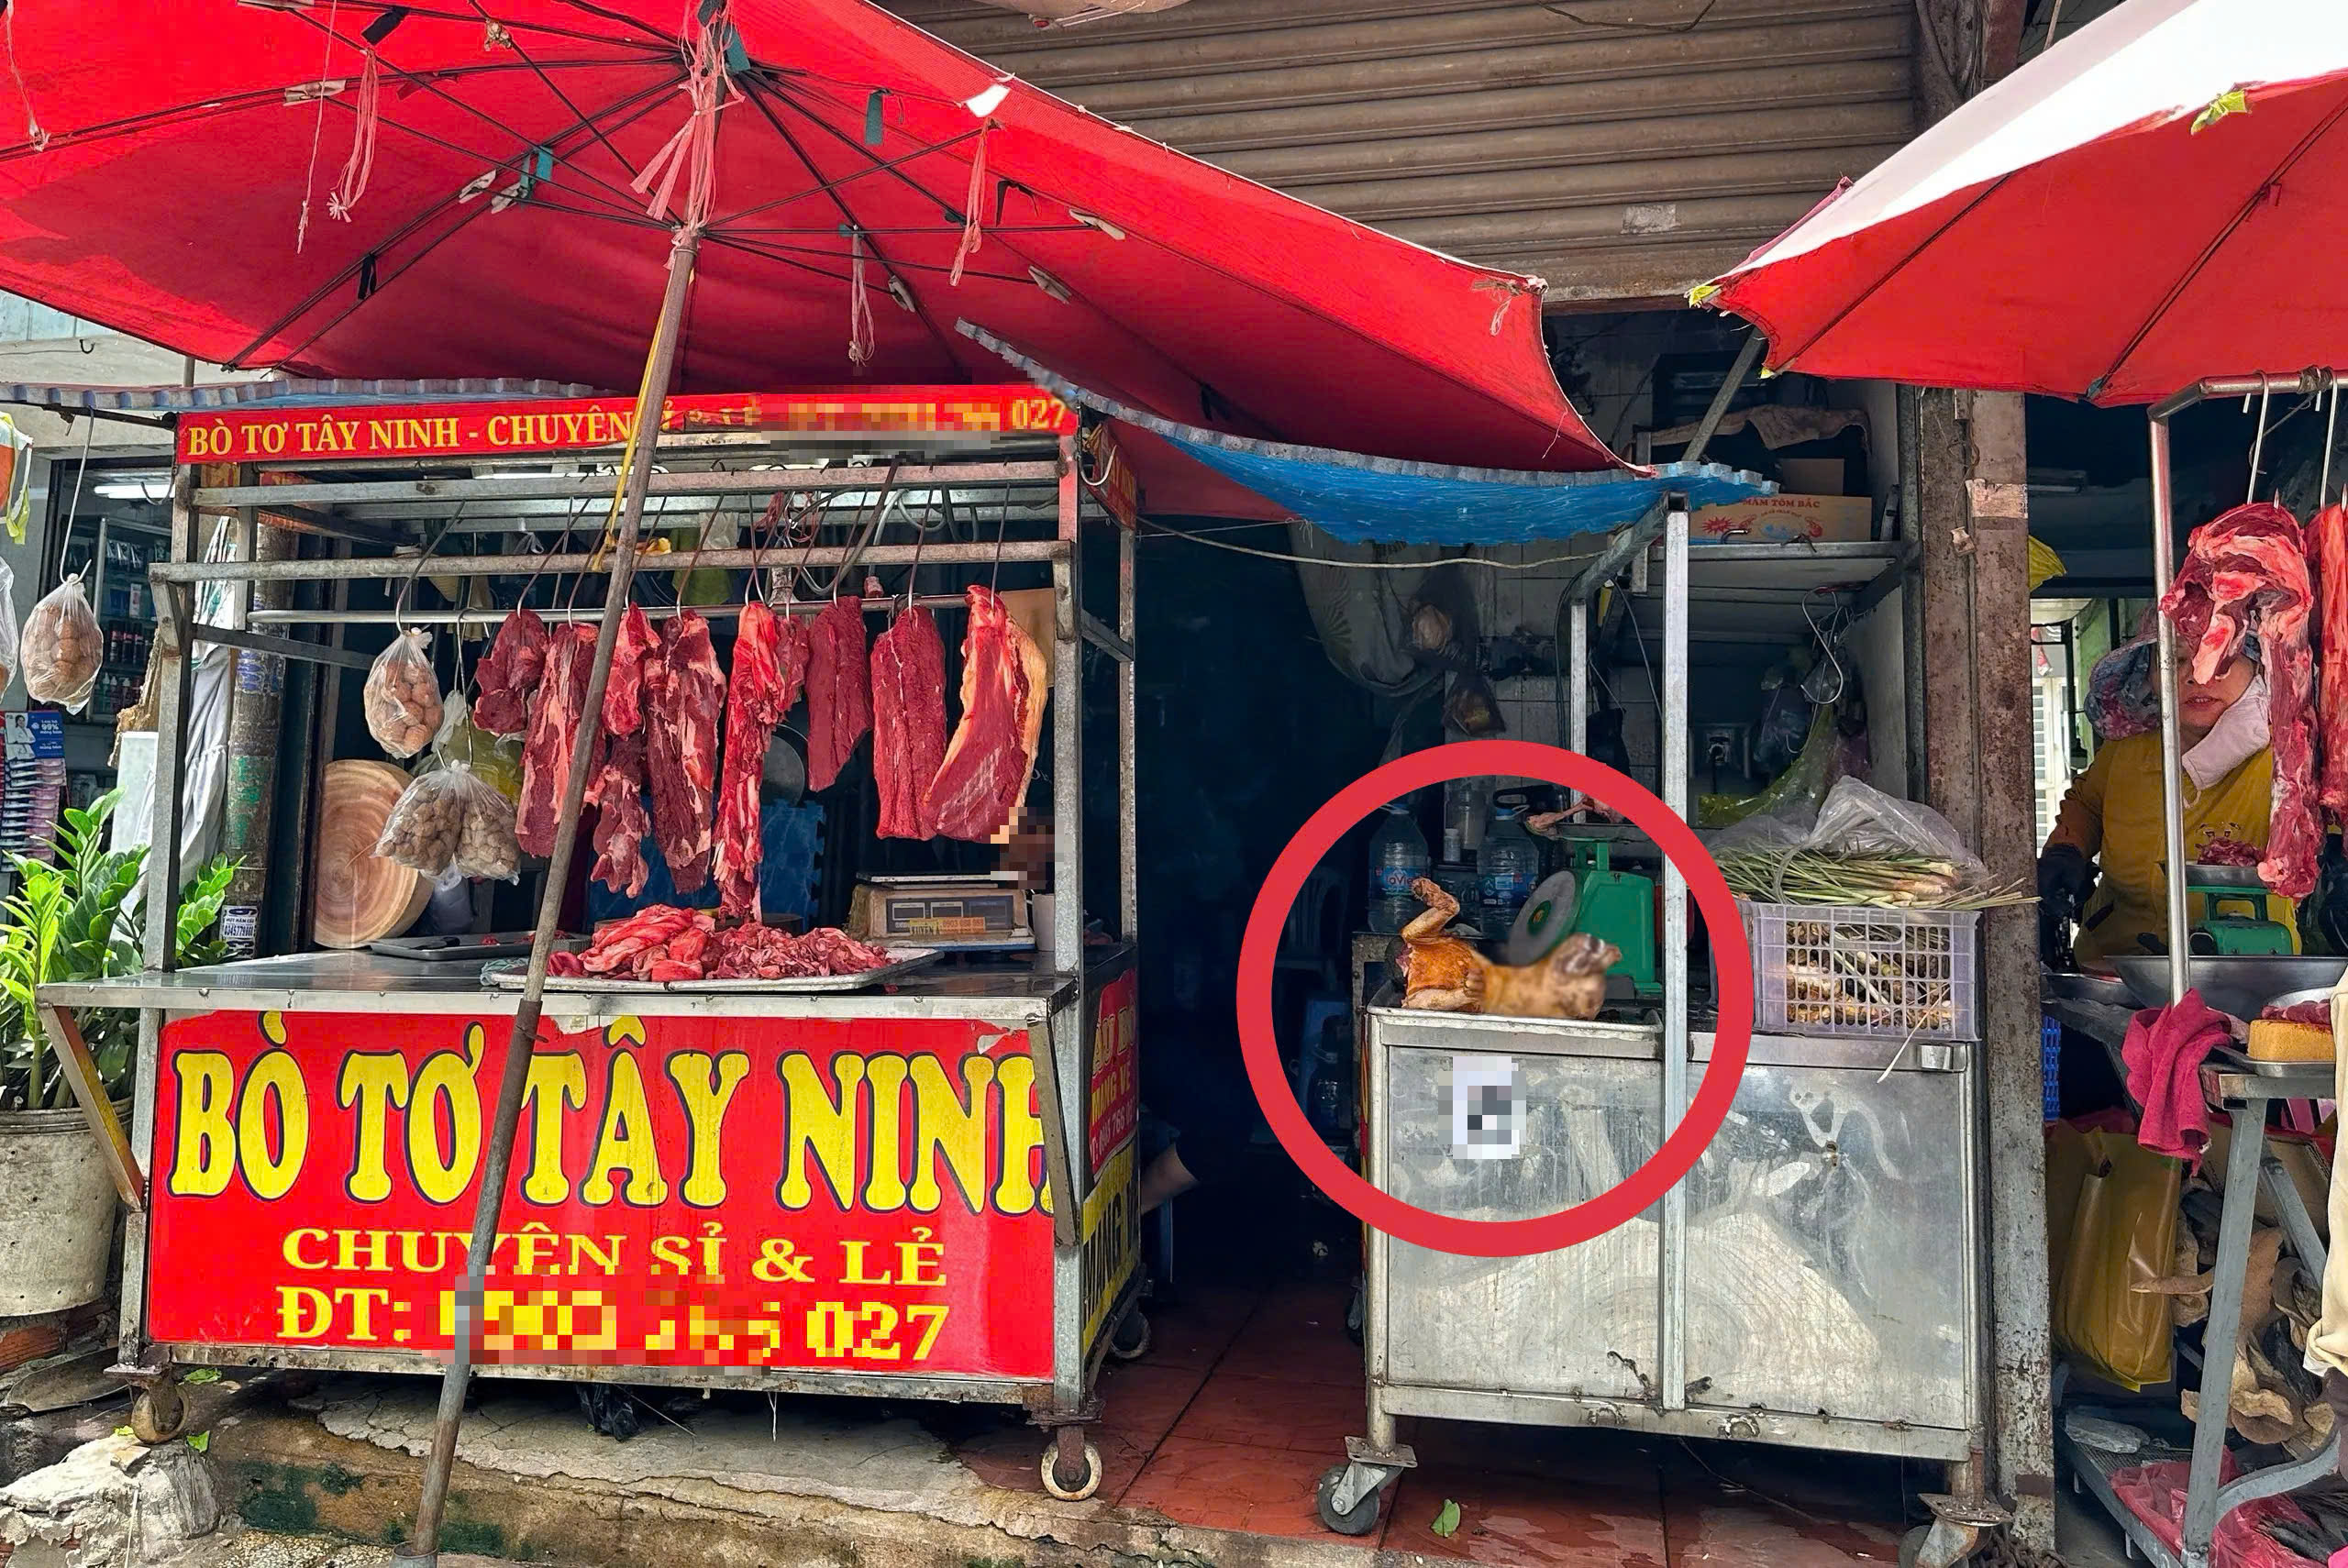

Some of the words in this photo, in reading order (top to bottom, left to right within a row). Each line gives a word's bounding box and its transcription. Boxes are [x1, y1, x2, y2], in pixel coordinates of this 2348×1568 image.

[187, 418, 233, 456] BÒ
[241, 422, 289, 454] TƠ
[296, 414, 359, 452] TÂY
[370, 416, 460, 449] NINH
[488, 404, 635, 447] CHUYÊN
[168, 1011, 309, 1202] BÒ
[337, 1021, 486, 1205] TƠ
[518, 1015, 752, 1207] TÂY
[776, 1049, 1054, 1216] NINH
[282, 1222, 626, 1275] CHUYÊN
[650, 1221, 727, 1283] SỈ
[751, 1238, 814, 1283] &
[838, 1226, 947, 1286] LẺ
[275, 1286, 411, 1342] ĐT:
[806, 1300, 950, 1361] 027
